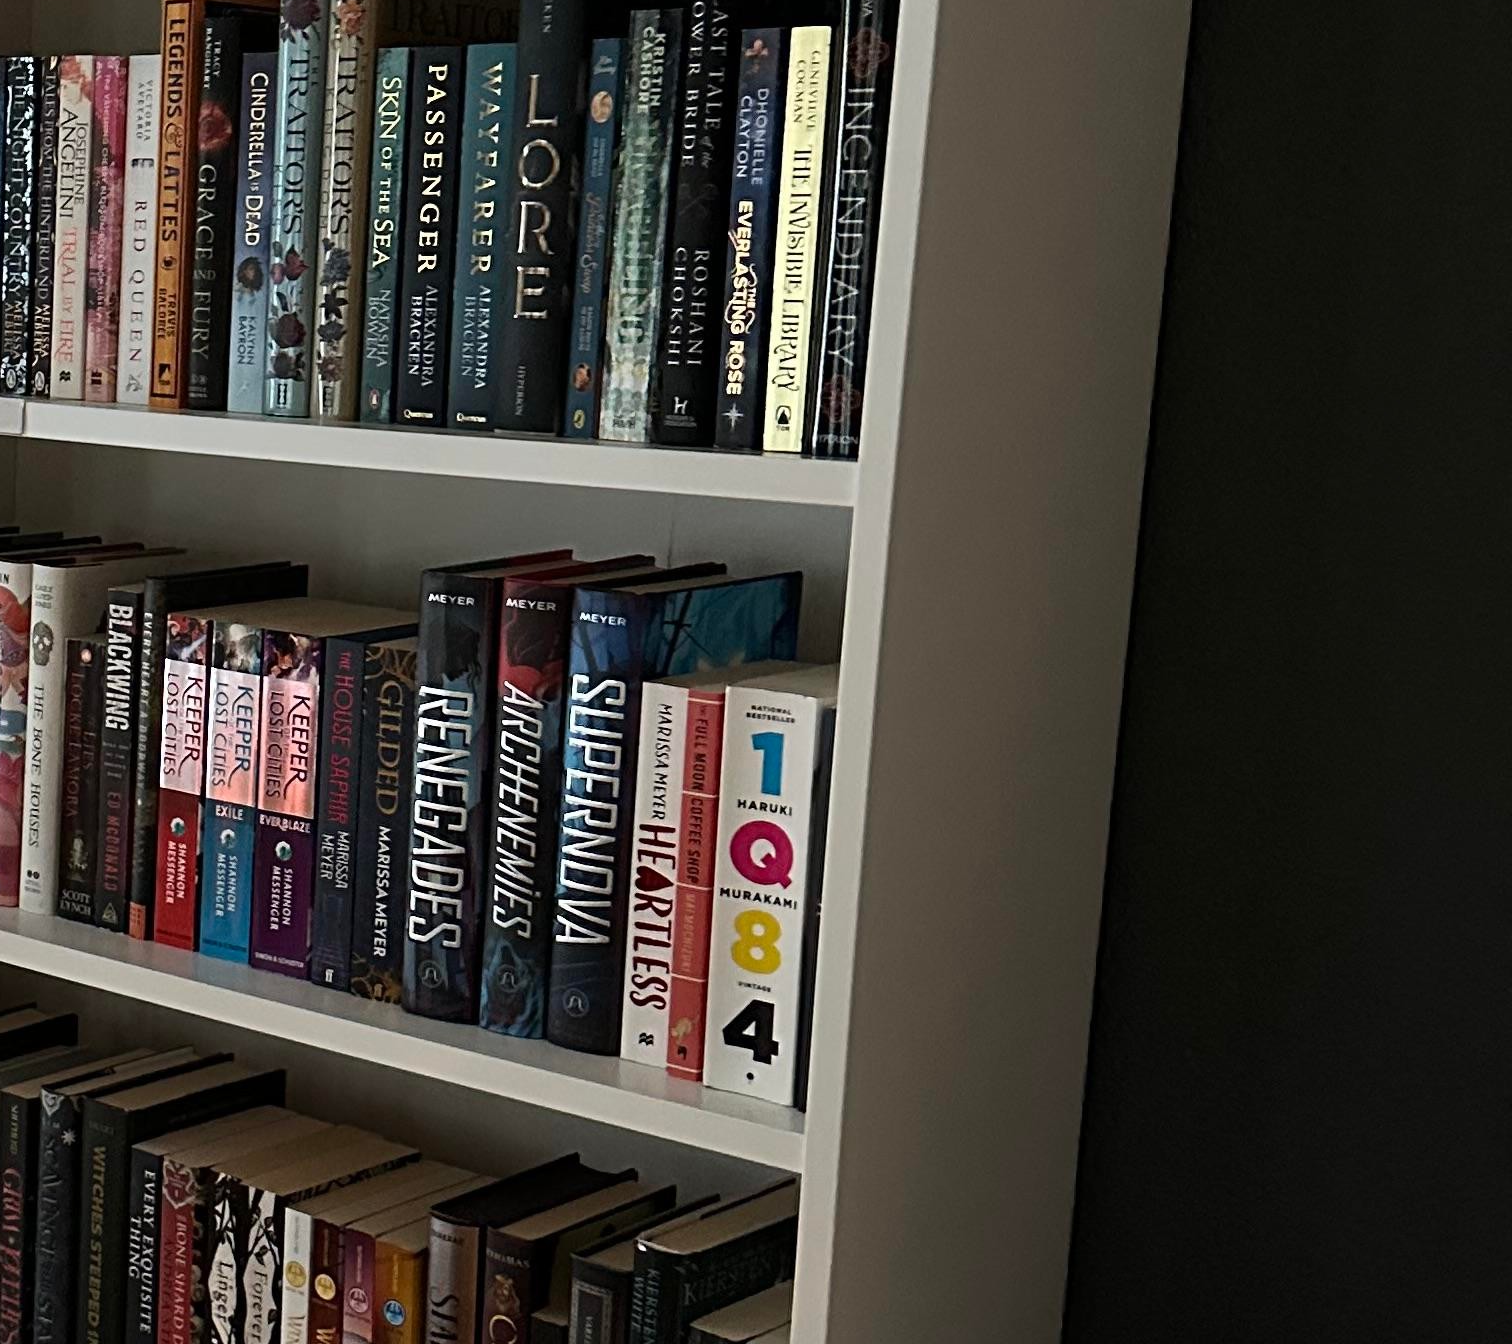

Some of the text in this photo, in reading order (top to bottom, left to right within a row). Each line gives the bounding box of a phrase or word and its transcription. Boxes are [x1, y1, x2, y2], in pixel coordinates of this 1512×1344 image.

[242, 71, 271, 247] CINDERELLA DEAD
[369, 76, 402, 268] SKIN OF THE SEA
[414, 64, 449, 275] PASSENGER
[467, 62, 505, 275] WAYFARER
[511, 74, 561, 320] LORE
[55, 108, 79, 363] ANGELINI TRIAL BY FIRE
[128, 199, 150, 363] RED QUEEN
[775, 145, 814, 392] THE INVISIBLE LIBRARY
[824, 85, 878, 367] INCENDIARY
[235, 315, 248, 366] BAYRON
[244, 316, 258, 366] KALYNN
[724, 200, 755, 395] EVERLASTING ROSE
[425, 592, 476, 607] MEYER
[503, 596, 557, 611] MEYER
[576, 611, 628, 627] MEYER
[103, 603, 134, 731] BLACKWING
[263, 691, 284, 798] LOST CITIES
[286, 694, 312, 784] KEEPER
[214, 805, 245, 819] EXILE
[370, 679, 406, 958] GILDED MARISSA MEYER
[405, 684, 476, 949] RENEGADES
[489, 680, 544, 940] ARCHENEMIES
[552, 672, 629, 946] SUPERNOVA
[628, 704, 677, 1011] MARISSA MEYER HEARTLESS
[685, 718, 709, 886] FULL MOON COFFEE SHOP
[729, 819, 796, 890] Q
[735, 798, 793, 816] HARUKI
[268, 865, 283, 931] MESSENGER
[280, 867, 293, 927] SHANNON
[718, 887, 798, 912] MURAKAMI
[729, 910, 782, 975] 8
[720, 998, 779, 1066] 4
[126, 1215, 142, 1280] THING
[137, 1169, 157, 1335] EVERY EXQUISITE
[213, 1261, 234, 1323] Linger
[248, 1270, 269, 1344] Forever
